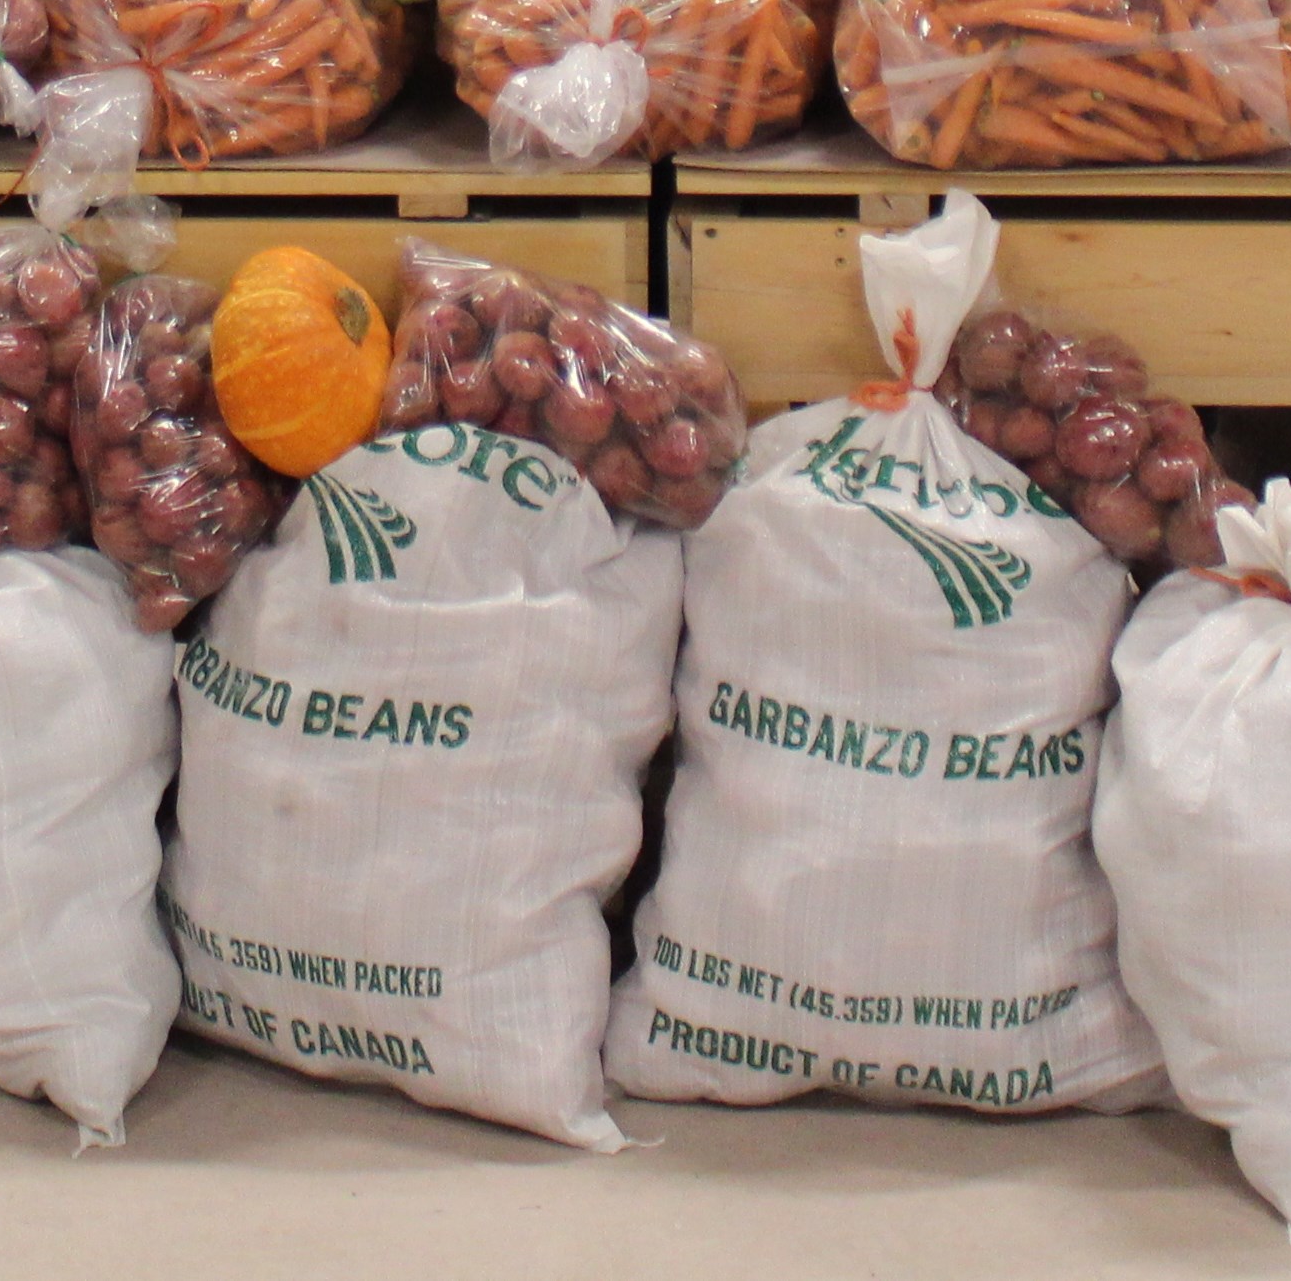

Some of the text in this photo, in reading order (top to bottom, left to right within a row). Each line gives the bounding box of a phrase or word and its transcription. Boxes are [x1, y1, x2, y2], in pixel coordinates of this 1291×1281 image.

[178, 636, 474, 749] RBANZO BEANS
[709, 681, 1086, 781] GARBANZO BEANS
[287, 949, 347, 990] WHEN
[354, 961, 444, 998] PACKED
[653, 934, 682, 973] 100
[688, 949, 732, 989] LBS
[737, 963, 785, 1004] NET
[789, 982, 904, 1025] (45.359)
[913, 994, 983, 1031] WHEN
[241, 1004, 279, 1044] OF
[290, 1019, 436, 1075] CANADA
[648, 1008, 1055, 1107] PRODUCT OF CANADA
